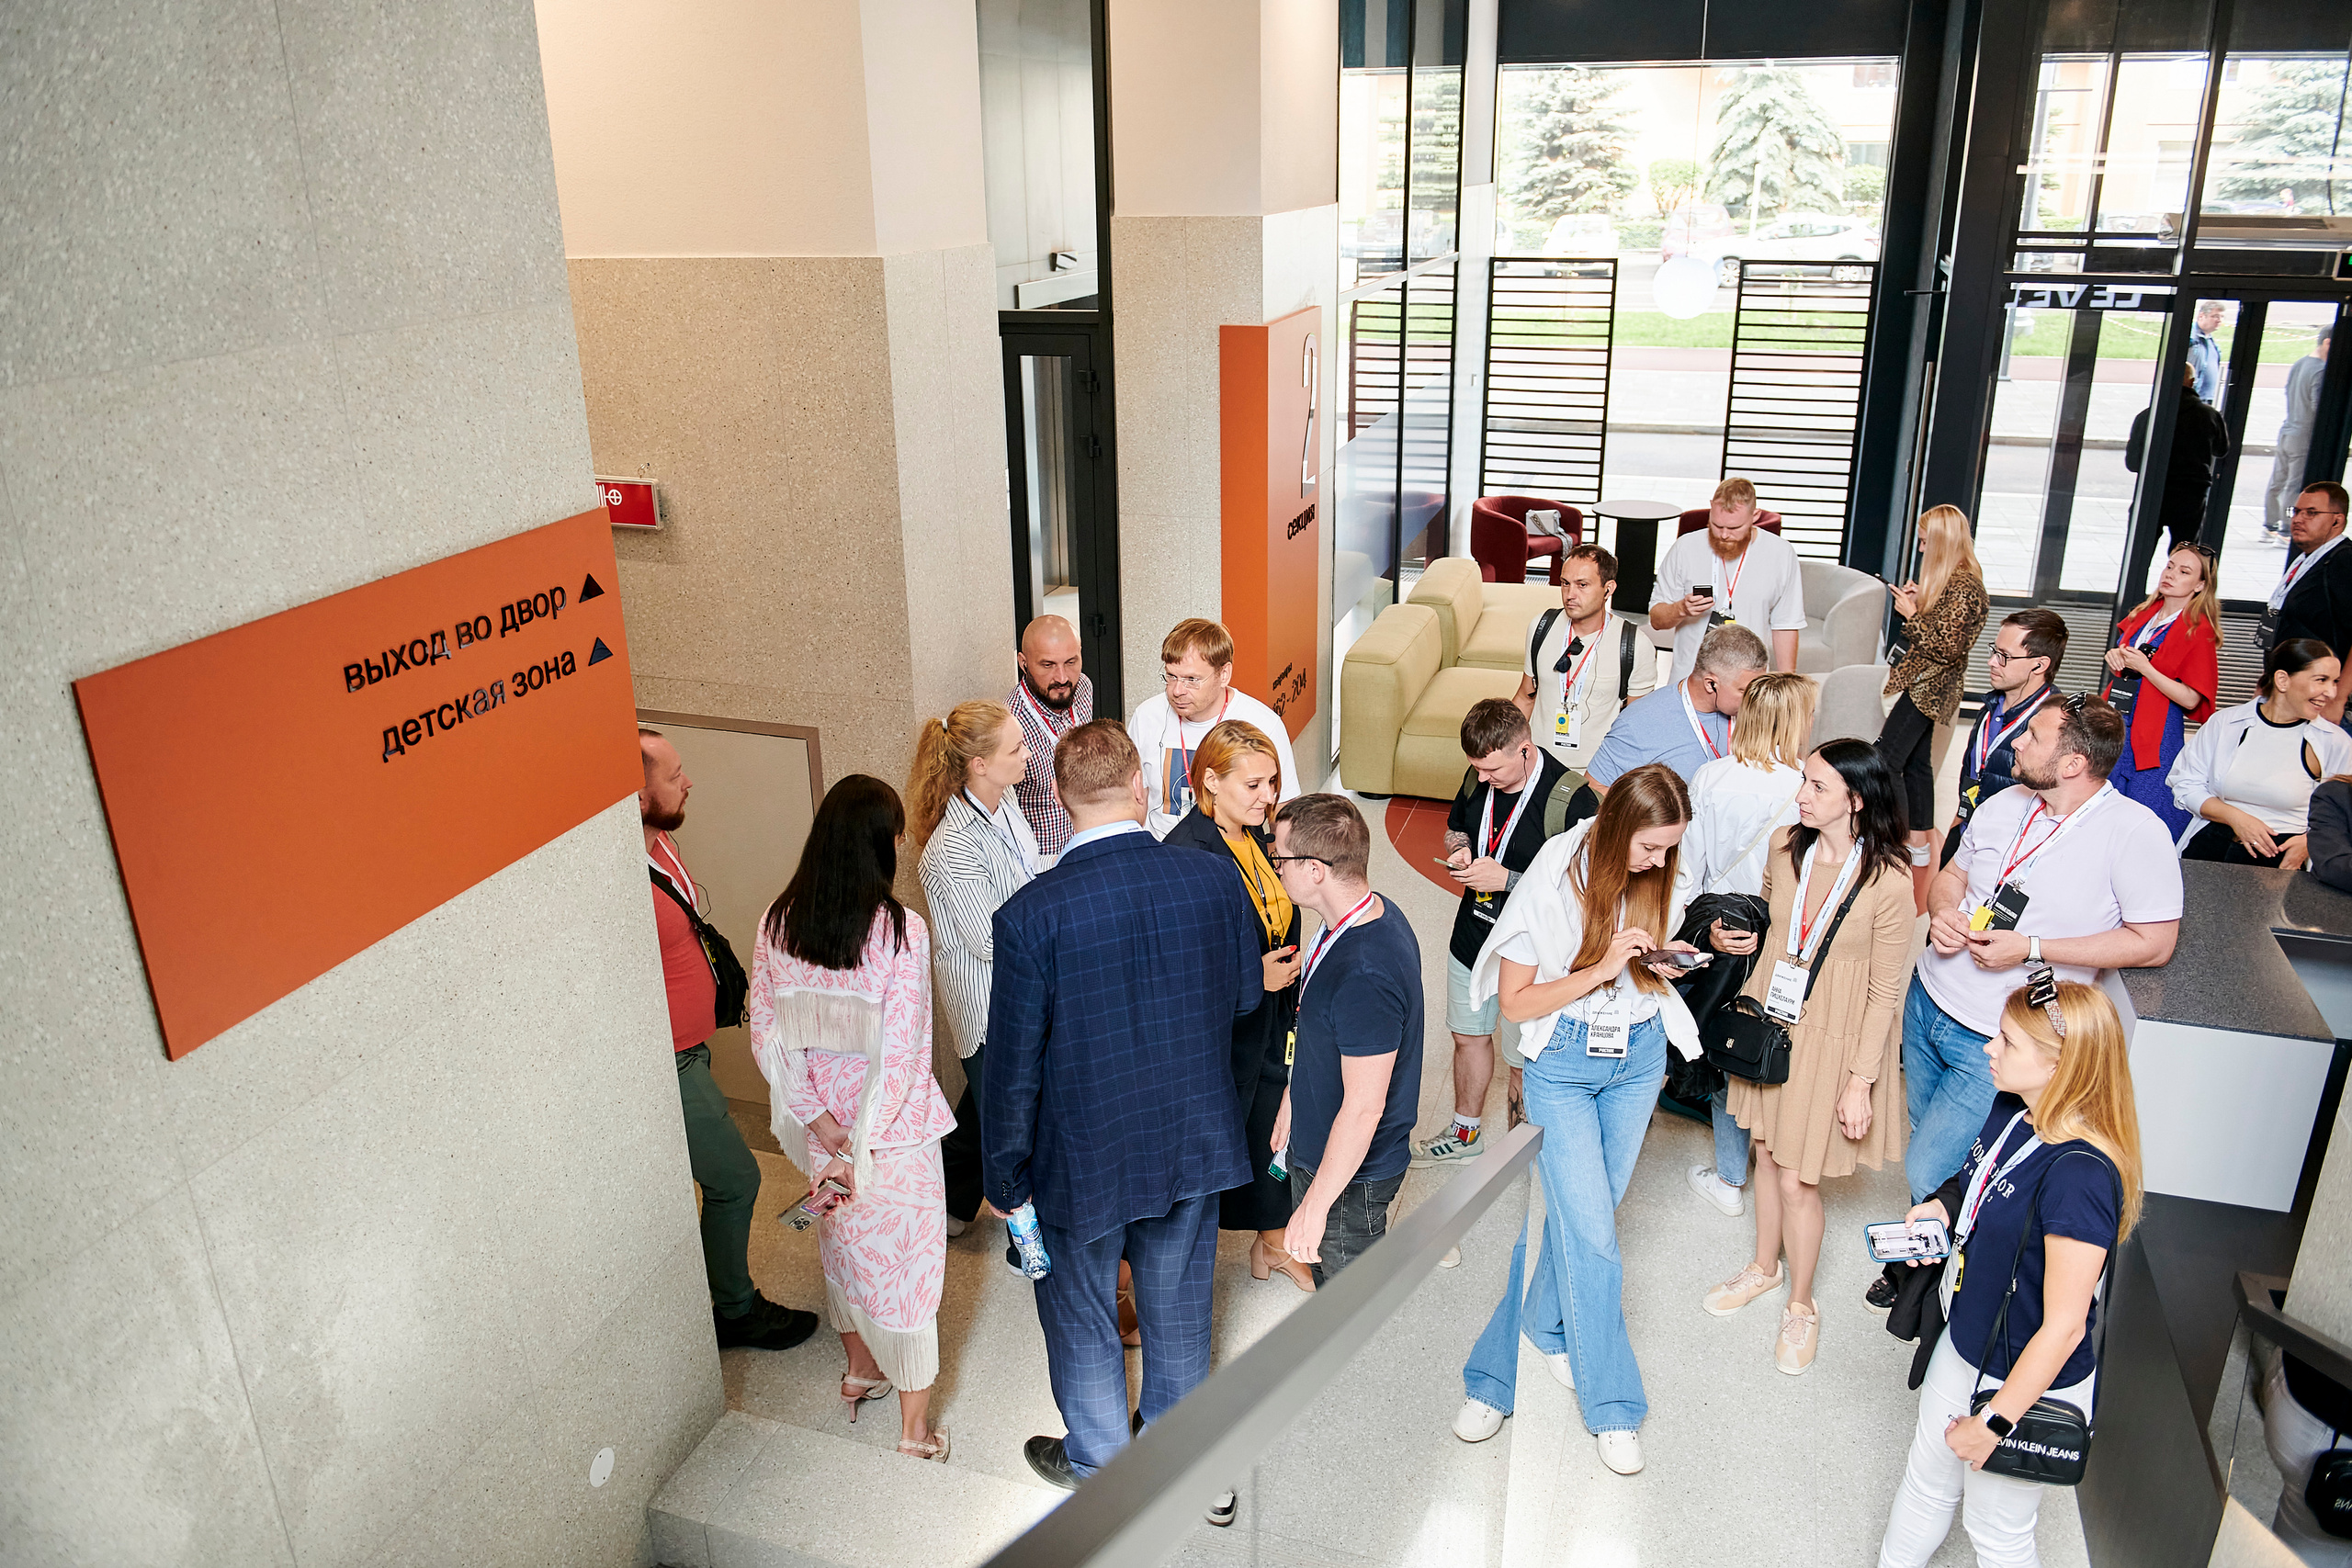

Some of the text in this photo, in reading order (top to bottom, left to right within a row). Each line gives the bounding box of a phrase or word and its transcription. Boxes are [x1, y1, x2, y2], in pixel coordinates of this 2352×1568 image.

[1300, 332, 1318, 500] 2
[1287, 502, 1316, 540] секция
[343, 585, 568, 694] выход во двор
[382, 649, 577, 763] детская зона
[1292, 667, 1307, 704] 204
[2018, 1439, 2047, 1455] KLEIN
[2047, 1447, 2080, 1461] JEANS
